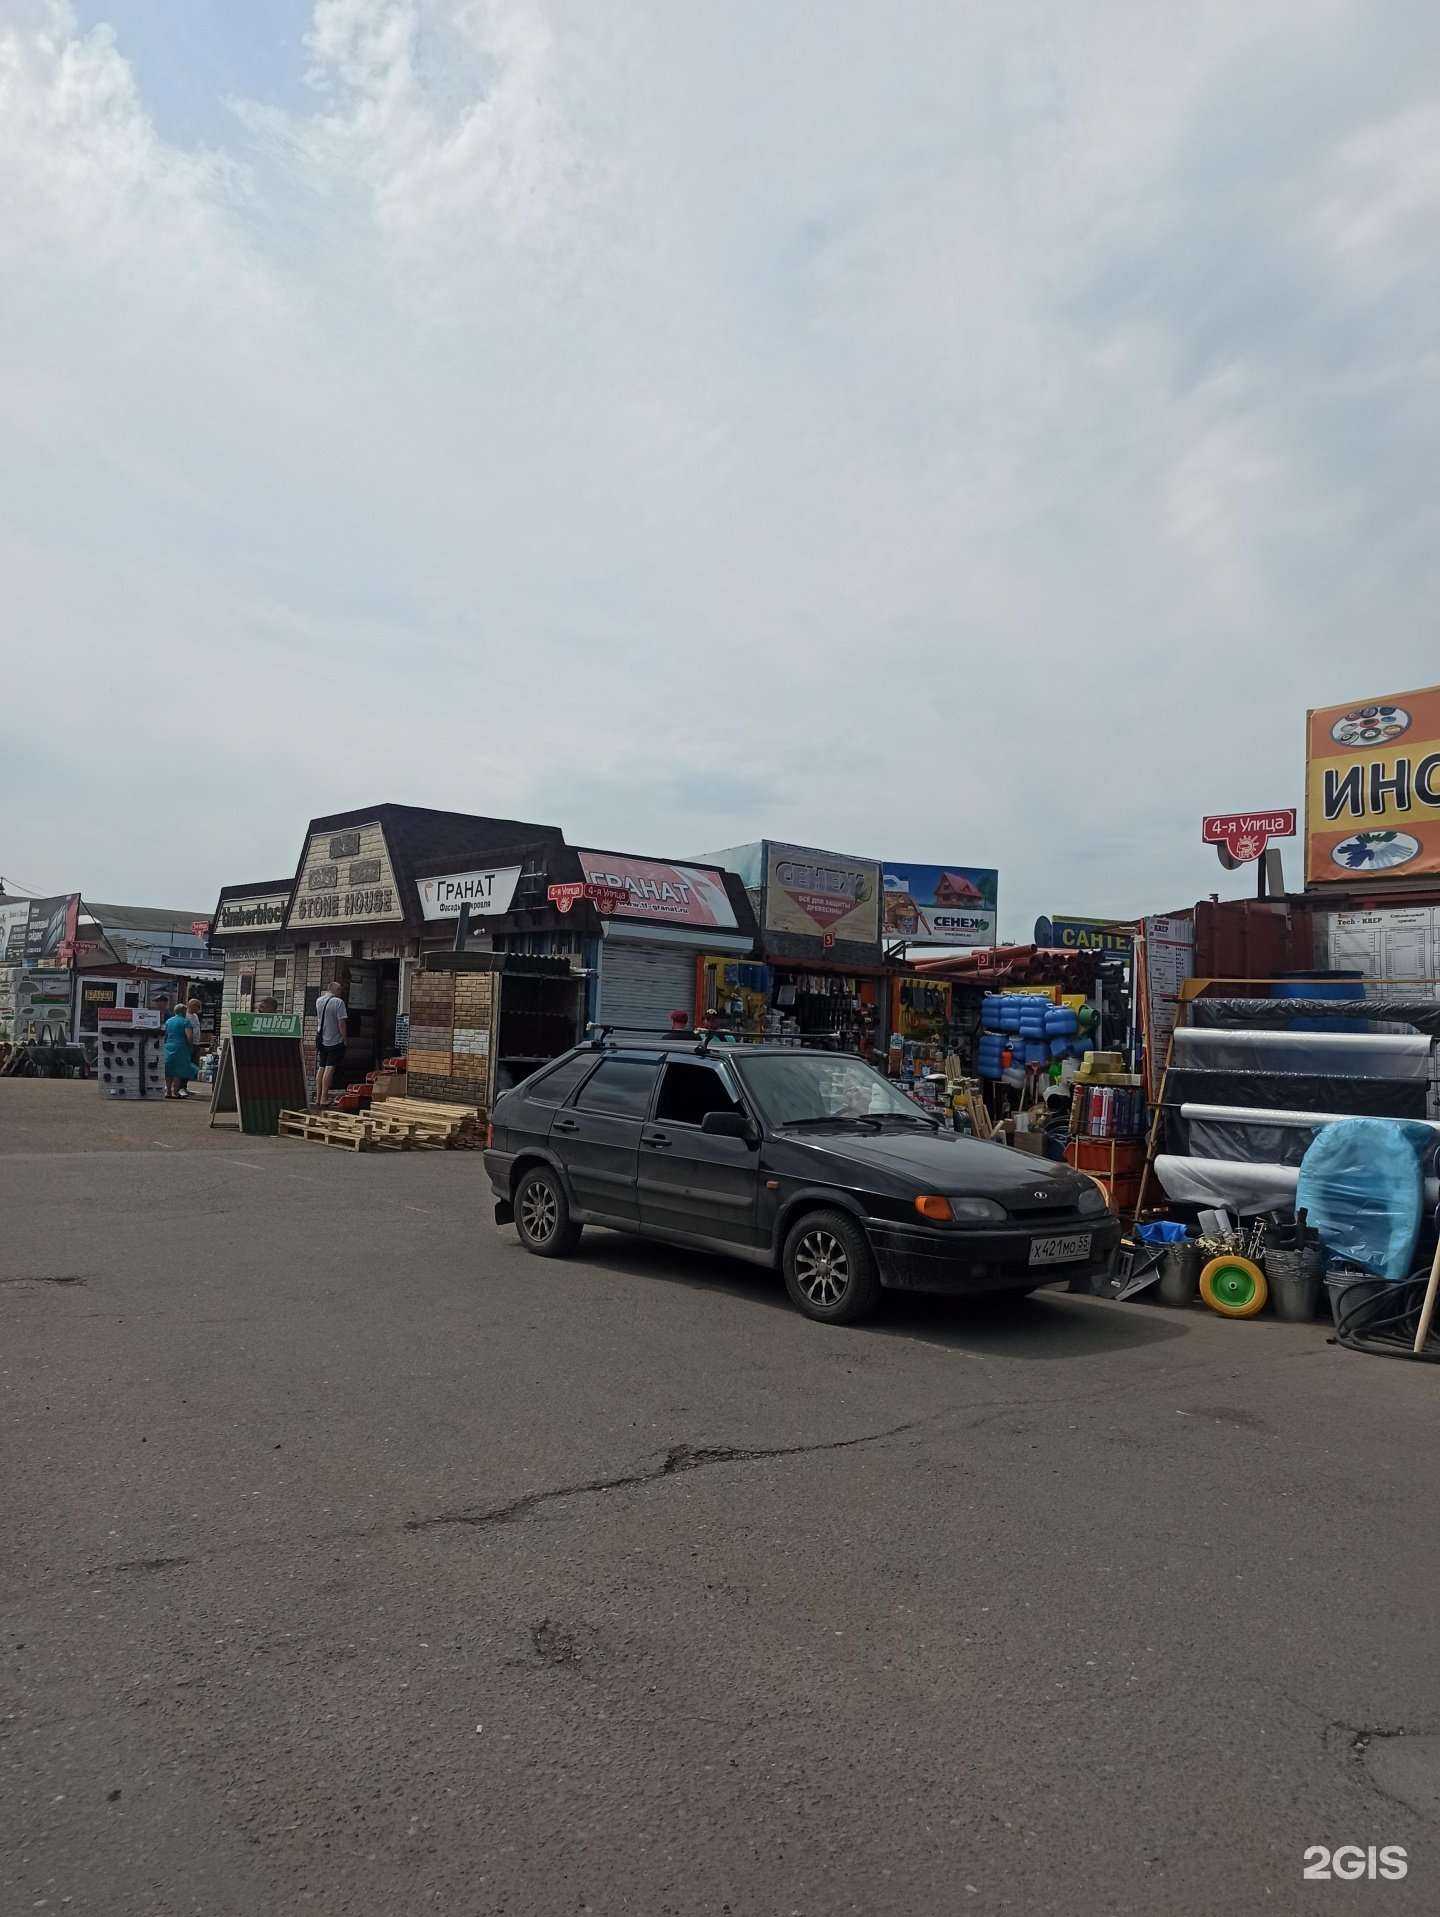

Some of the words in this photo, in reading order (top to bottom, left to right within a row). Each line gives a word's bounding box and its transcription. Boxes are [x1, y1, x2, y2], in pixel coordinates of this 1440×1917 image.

[1212, 818, 1237, 834] 4-я
[1240, 816, 1285, 833] Улица
[437, 873, 496, 901] ГРАНАТ
[550, 887, 561, 897] 4-я
[562, 886, 580, 896] Улица
[587, 887, 602, 897] 4-я
[602, 888, 626, 899] Улица
[298, 896, 340, 920] STONE
[345, 889, 393, 916] HOUSE
